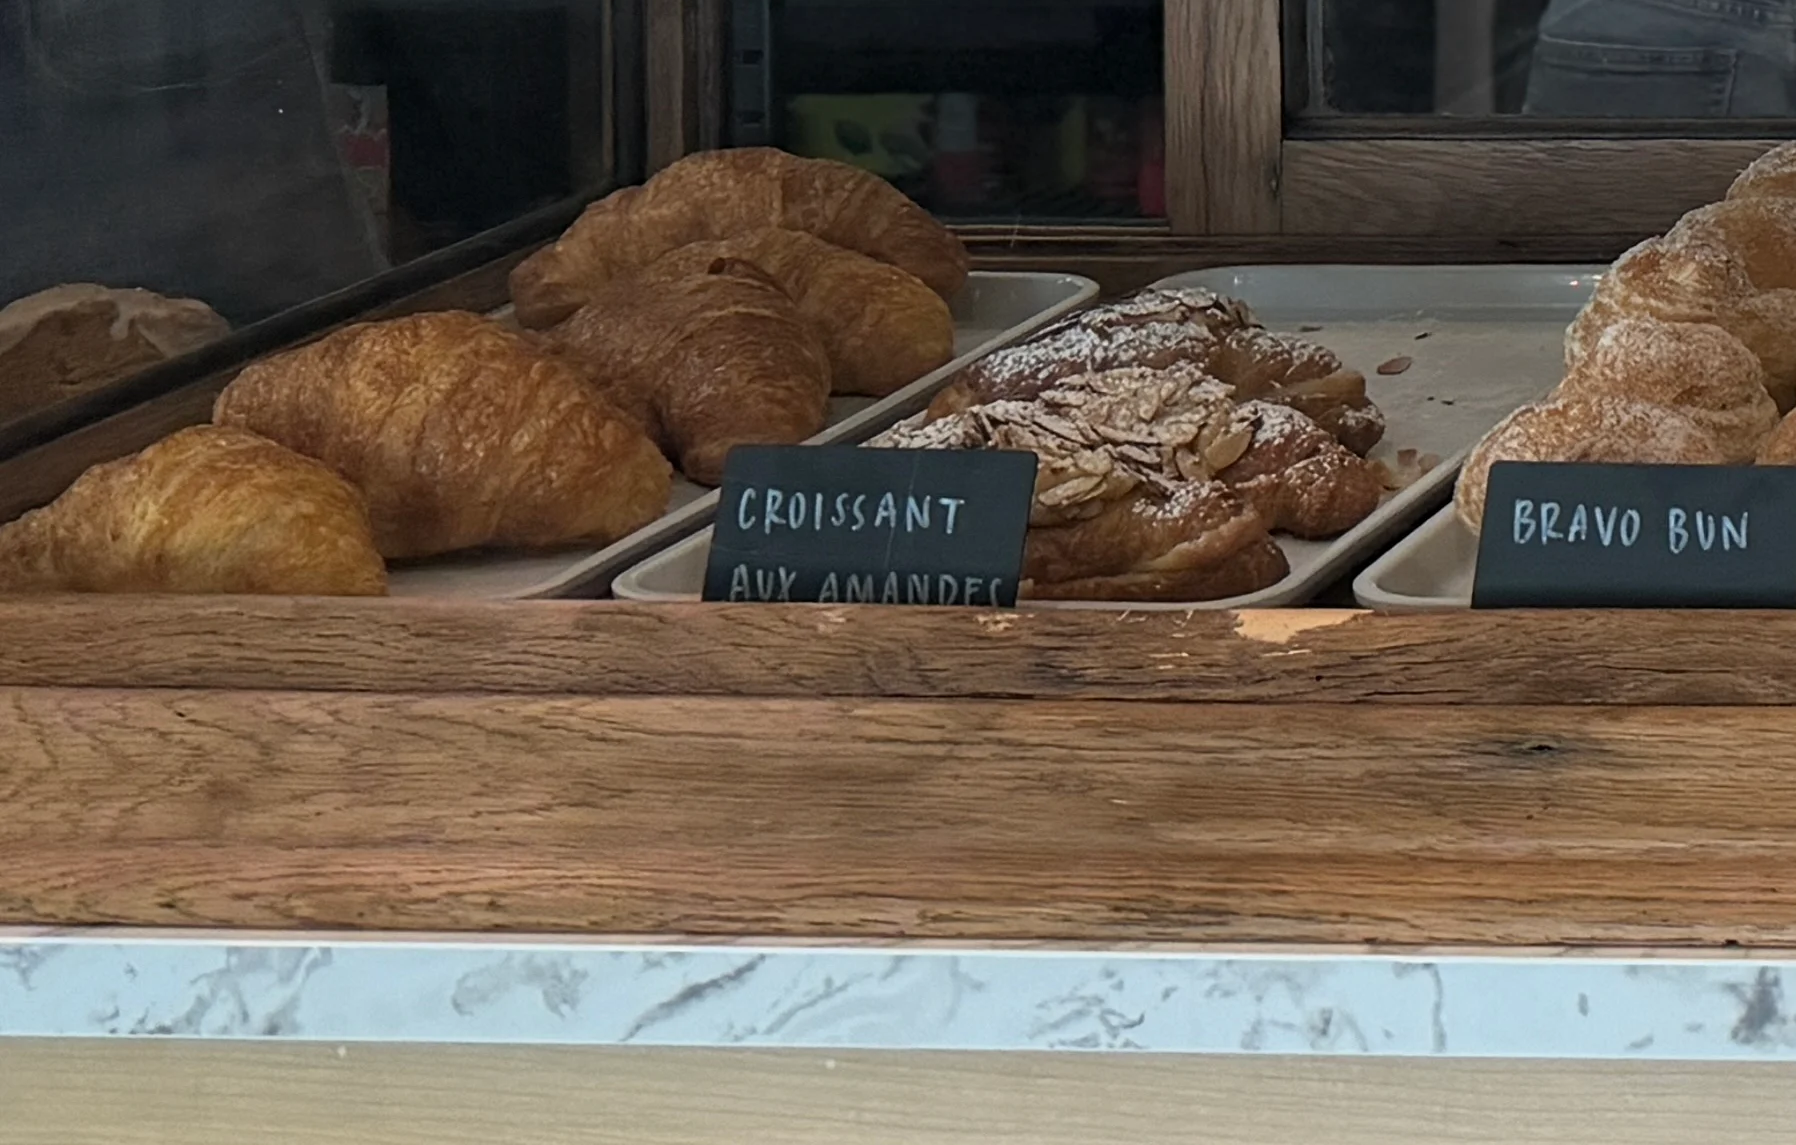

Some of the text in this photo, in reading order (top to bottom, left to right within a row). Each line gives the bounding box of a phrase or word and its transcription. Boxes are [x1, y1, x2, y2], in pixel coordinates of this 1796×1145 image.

[738, 487, 966, 535] CROISSANT
[1512, 498, 1749, 554] BRAVO BUN
[729, 563, 798, 602] AUX
